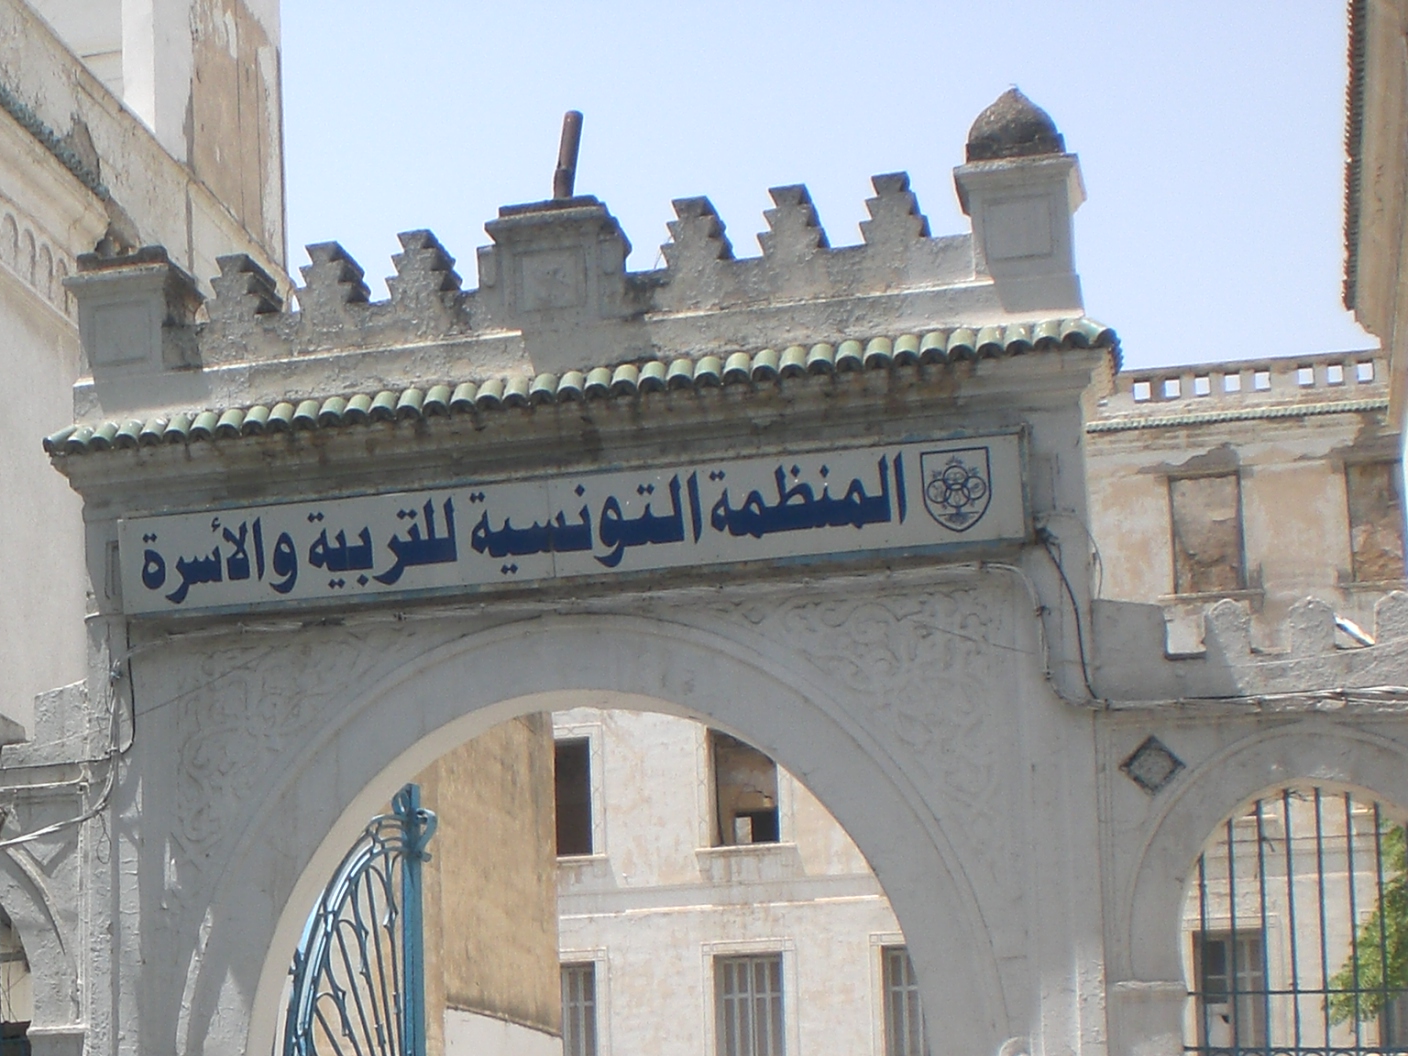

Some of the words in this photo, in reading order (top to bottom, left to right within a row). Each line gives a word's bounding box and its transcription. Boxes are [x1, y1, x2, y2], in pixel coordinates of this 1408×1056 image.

[470, 470, 703, 575] التونسية
[708, 451, 908, 539] المنظمة
[142, 516, 298, 604] والأسرة
[308, 496, 459, 589] للتربية
